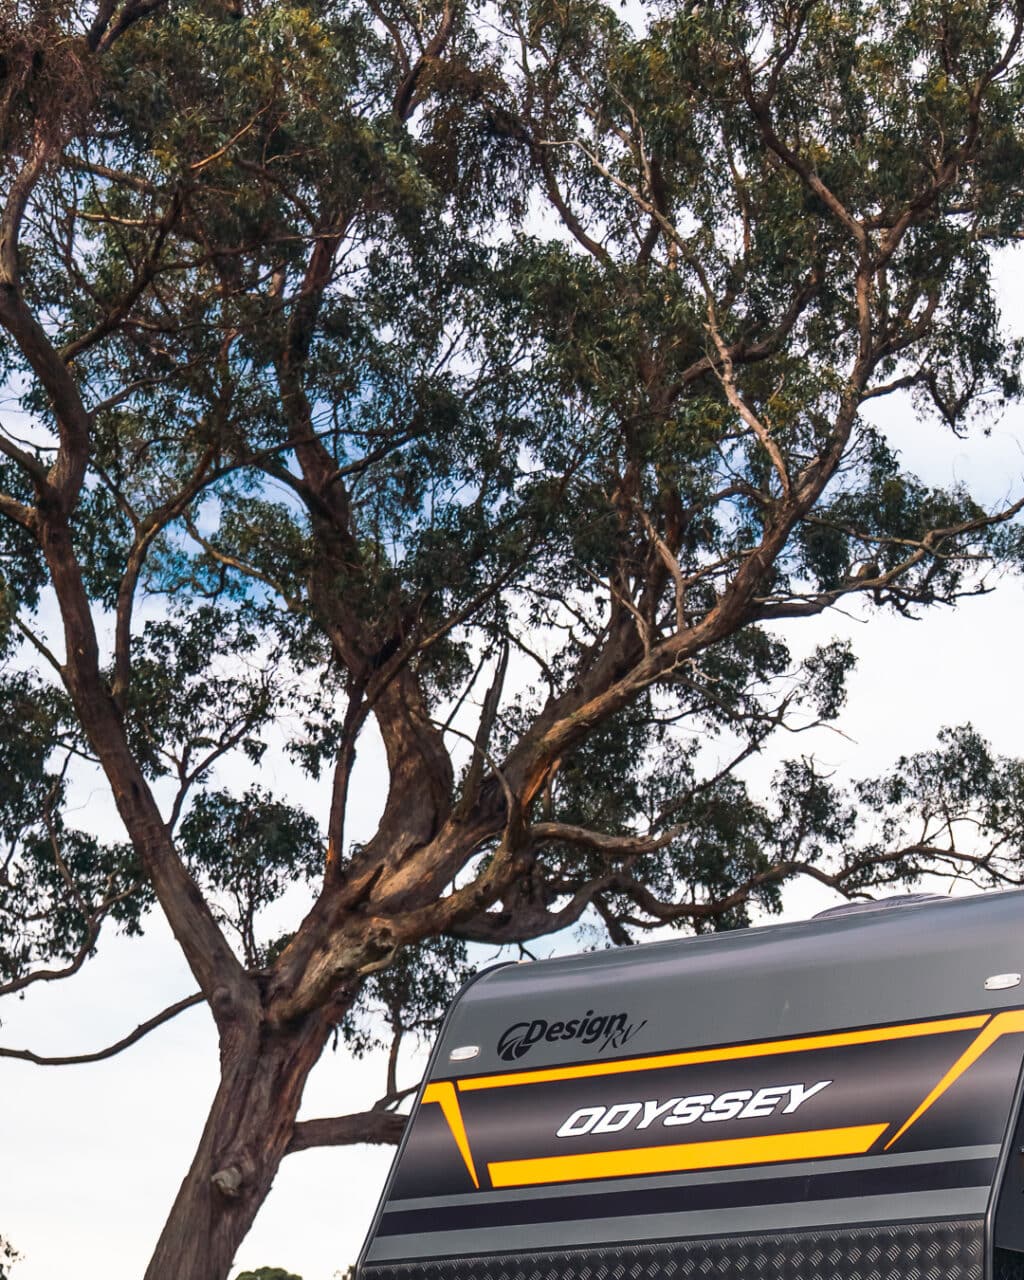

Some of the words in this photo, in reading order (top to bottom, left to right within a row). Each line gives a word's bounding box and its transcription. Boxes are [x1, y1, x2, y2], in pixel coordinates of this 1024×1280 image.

[523, 1009, 628, 1044] Design
[598, 1019, 648, 1053] RV
[556, 1080, 833, 1137] ODYSSEY
